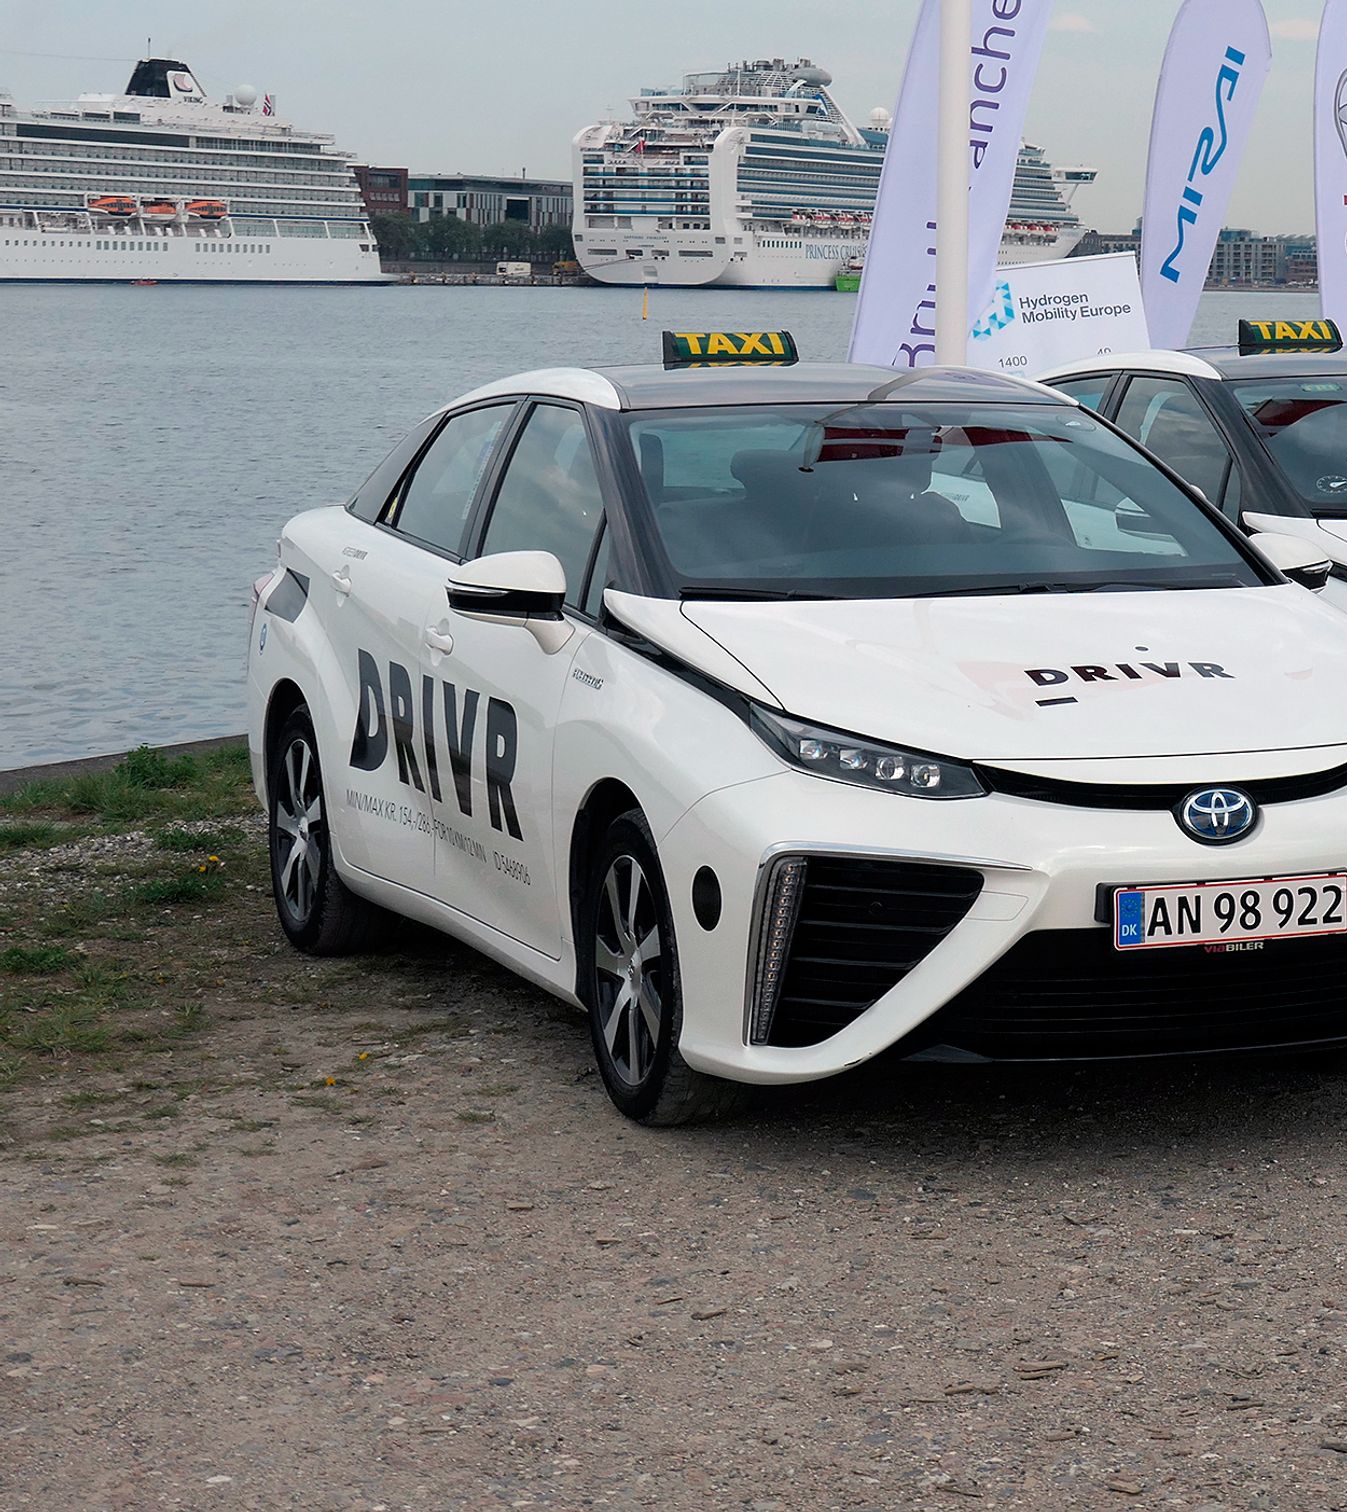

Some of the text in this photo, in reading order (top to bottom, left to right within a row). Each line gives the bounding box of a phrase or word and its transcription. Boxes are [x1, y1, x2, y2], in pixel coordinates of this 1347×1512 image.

[1160, 46, 1245, 283] MIRAI
[805, 244, 840, 259] PRINCESS
[1019, 293, 1089, 311] Hydrogen
[1022, 302, 1131, 324] Mobility Europe
[1249, 320, 1332, 339] TAXI
[674, 332, 785, 354] TAXI
[999, 355, 1028, 368] 1400
[1024, 646, 1236, 687] DRIVR
[349, 648, 524, 841] DRIVR
[1121, 885, 1343, 937] DK AN 98 922
